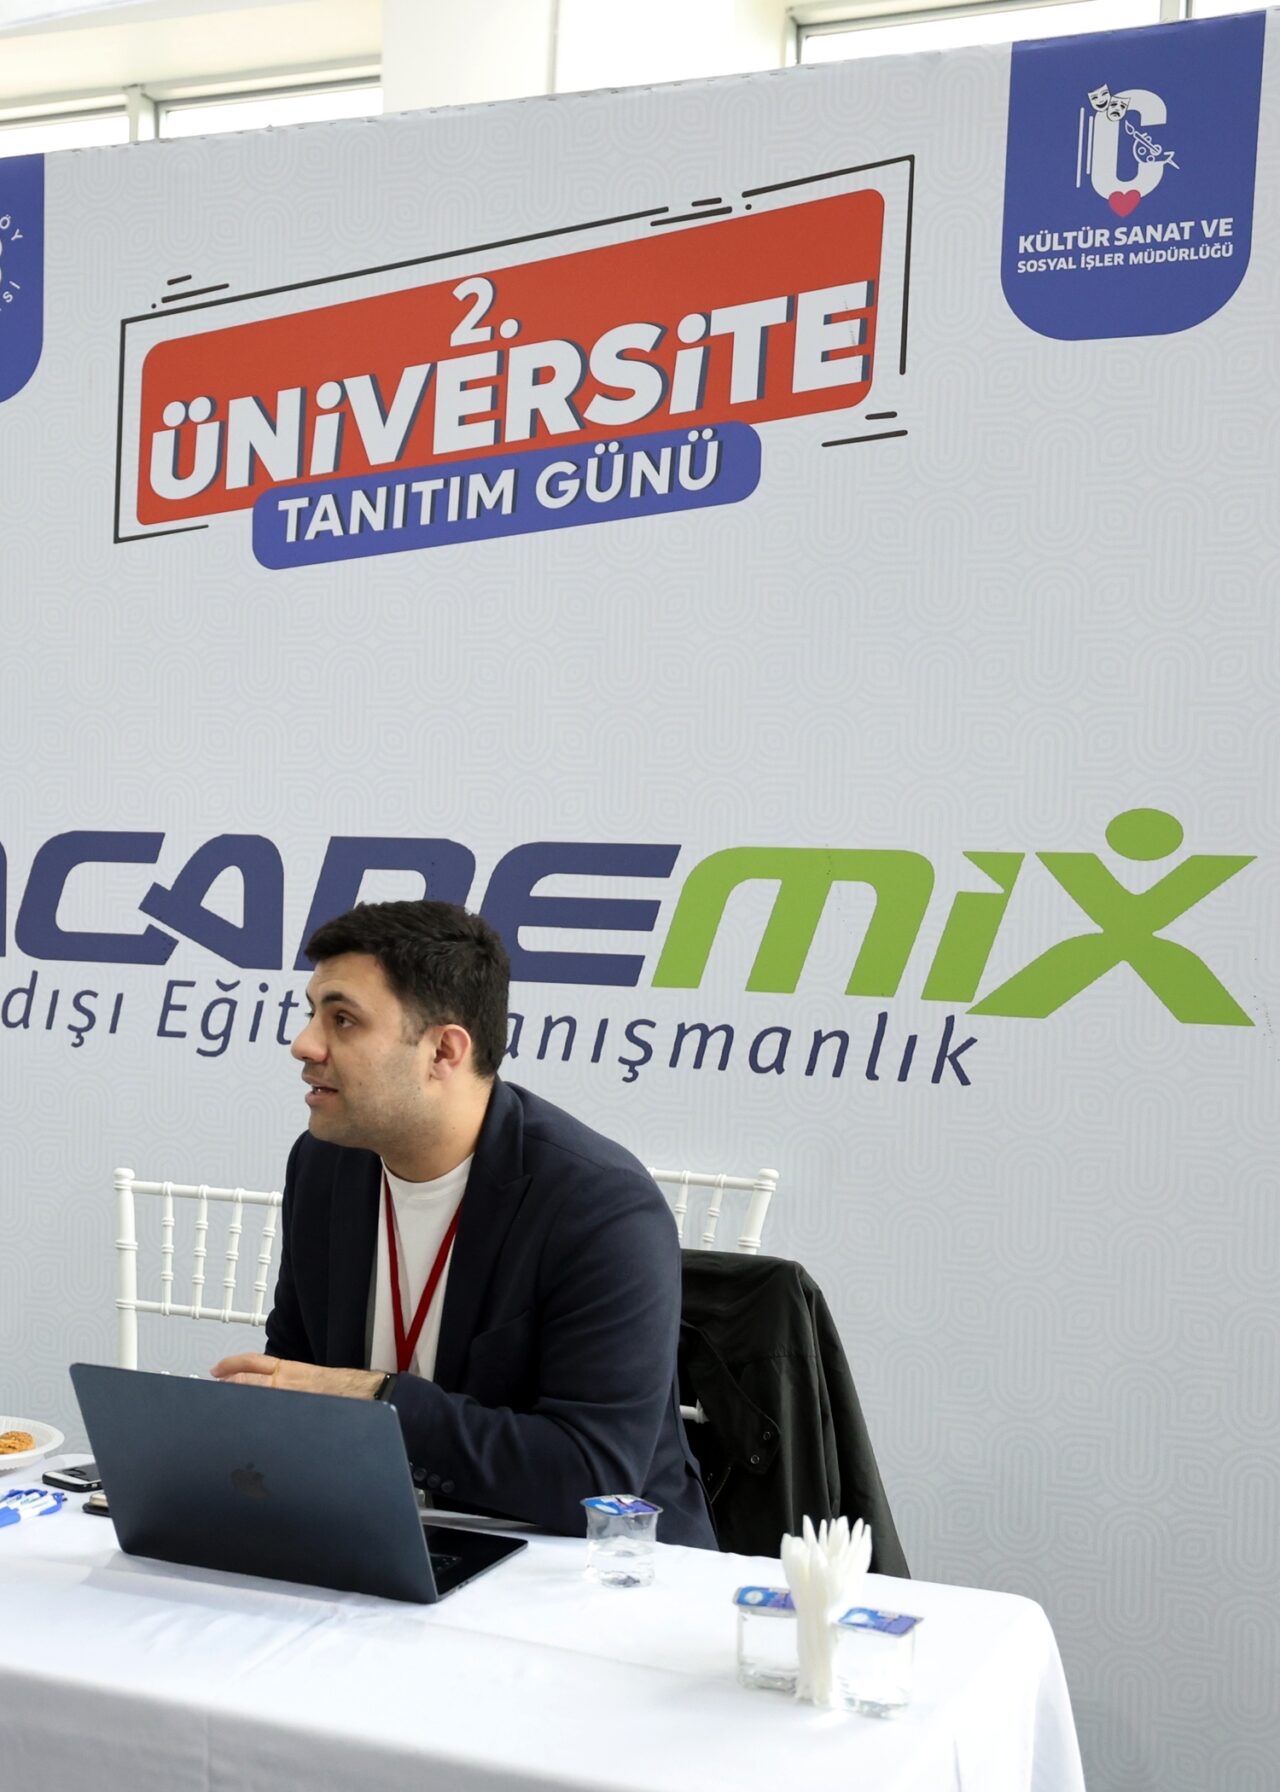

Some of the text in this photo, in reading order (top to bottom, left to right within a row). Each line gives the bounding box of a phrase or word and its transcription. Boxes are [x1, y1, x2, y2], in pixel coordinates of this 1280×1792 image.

[1017, 241, 1234, 273] SOSYAL İŞLER MÜDÜRLÜĞÜ
[1018, 217, 1234, 254] KÜLTÜR SANAT VE
[450, 276, 521, 348] 2.
[277, 427, 722, 544] TANITIM GÜNÜ
[156, 978, 300, 1058] Eğit
[505, 1010, 979, 1087] anışmanlık
